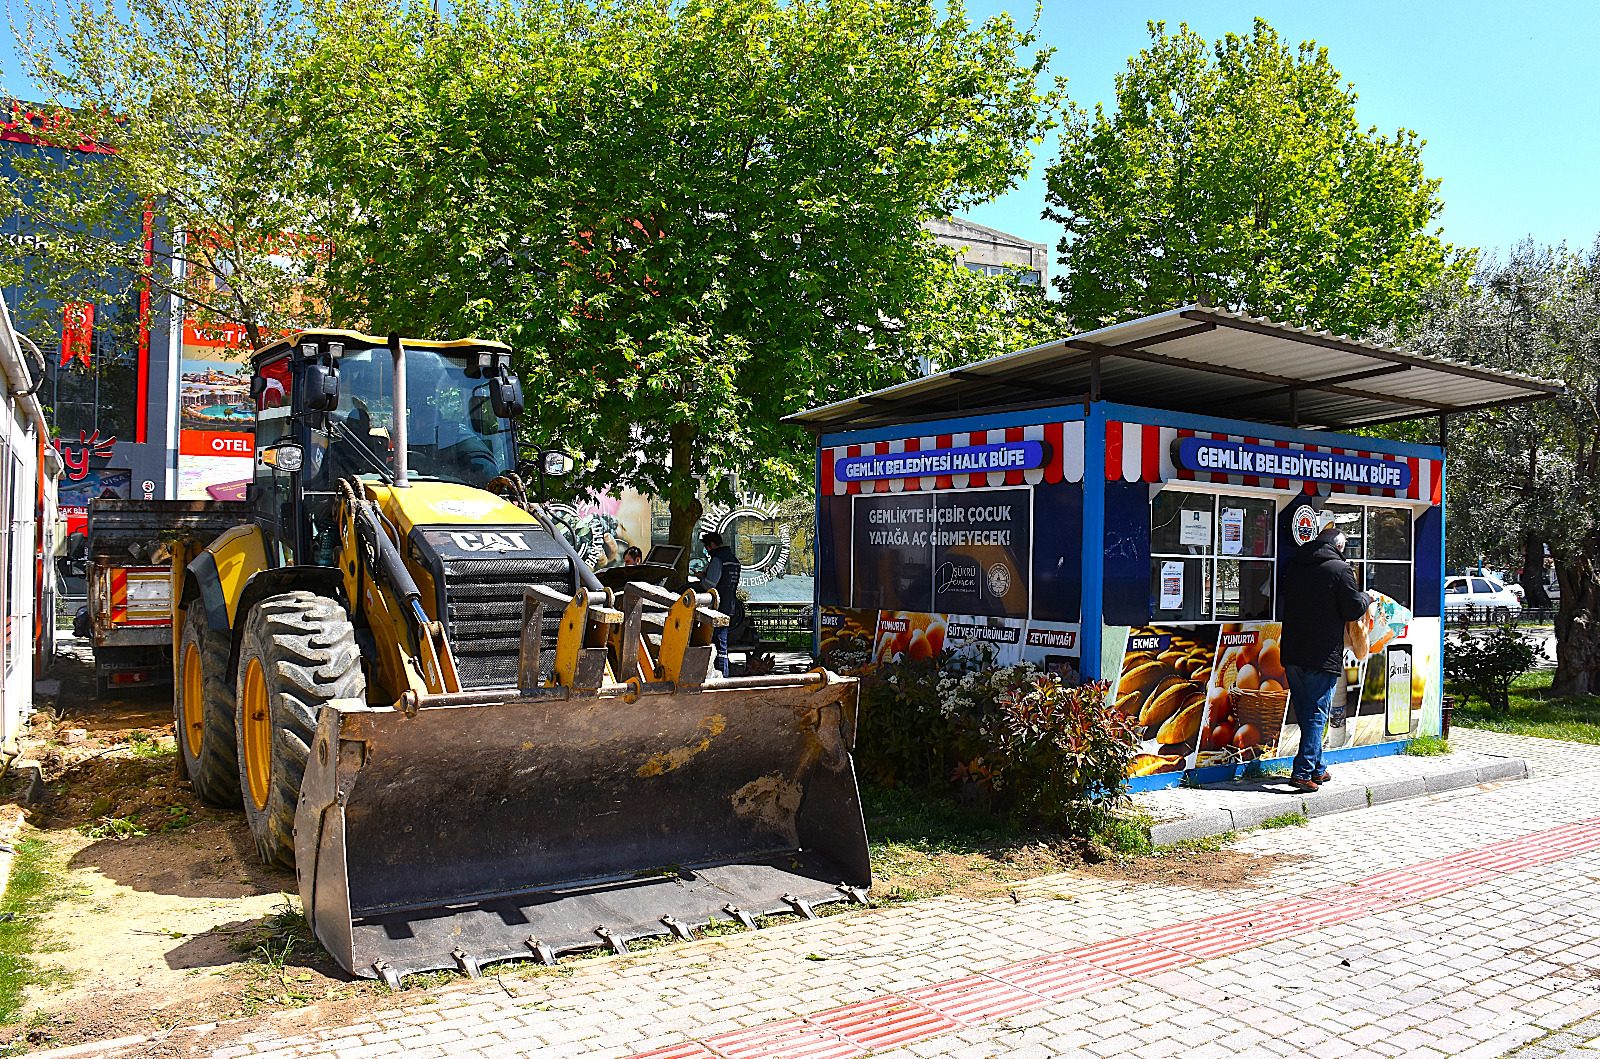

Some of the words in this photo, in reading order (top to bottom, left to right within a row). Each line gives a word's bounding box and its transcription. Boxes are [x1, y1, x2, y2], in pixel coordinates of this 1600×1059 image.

[211, 438, 252, 452] OTEL
[845, 458, 885, 478] GEMLİK
[885, 452, 951, 475] BELEDİYESİ
[952, 452, 988, 470] HALK
[989, 447, 1025, 467] BÜFE
[1197, 446, 1254, 472] GEMLİK
[1255, 453, 1333, 479] BELEDİYESİ
[1334, 461, 1369, 483] HALK
[1370, 463, 1401, 486] BÜFE
[926, 505, 965, 526] HİÇBİR
[967, 505, 1012, 525] ÇOCUK
[450, 532, 532, 552] CAT
[868, 527, 910, 546] YATAĞA
[911, 530, 928, 548] AÇ
[929, 528, 1011, 546] GİRMEYECEK!
[880, 620, 907, 632] YUMURTA
[948, 624, 960, 637] SÜT
[961, 627, 970, 637] VE
[970, 626, 983, 639] SÜT
[983, 625, 1016, 642] ÜRÜNLERİ
[1029, 631, 1072, 647] ZEYTİNYAĞI
[1132, 636, 1160, 650] EKMEK
[1222, 634, 1255, 645] YUMURTA
